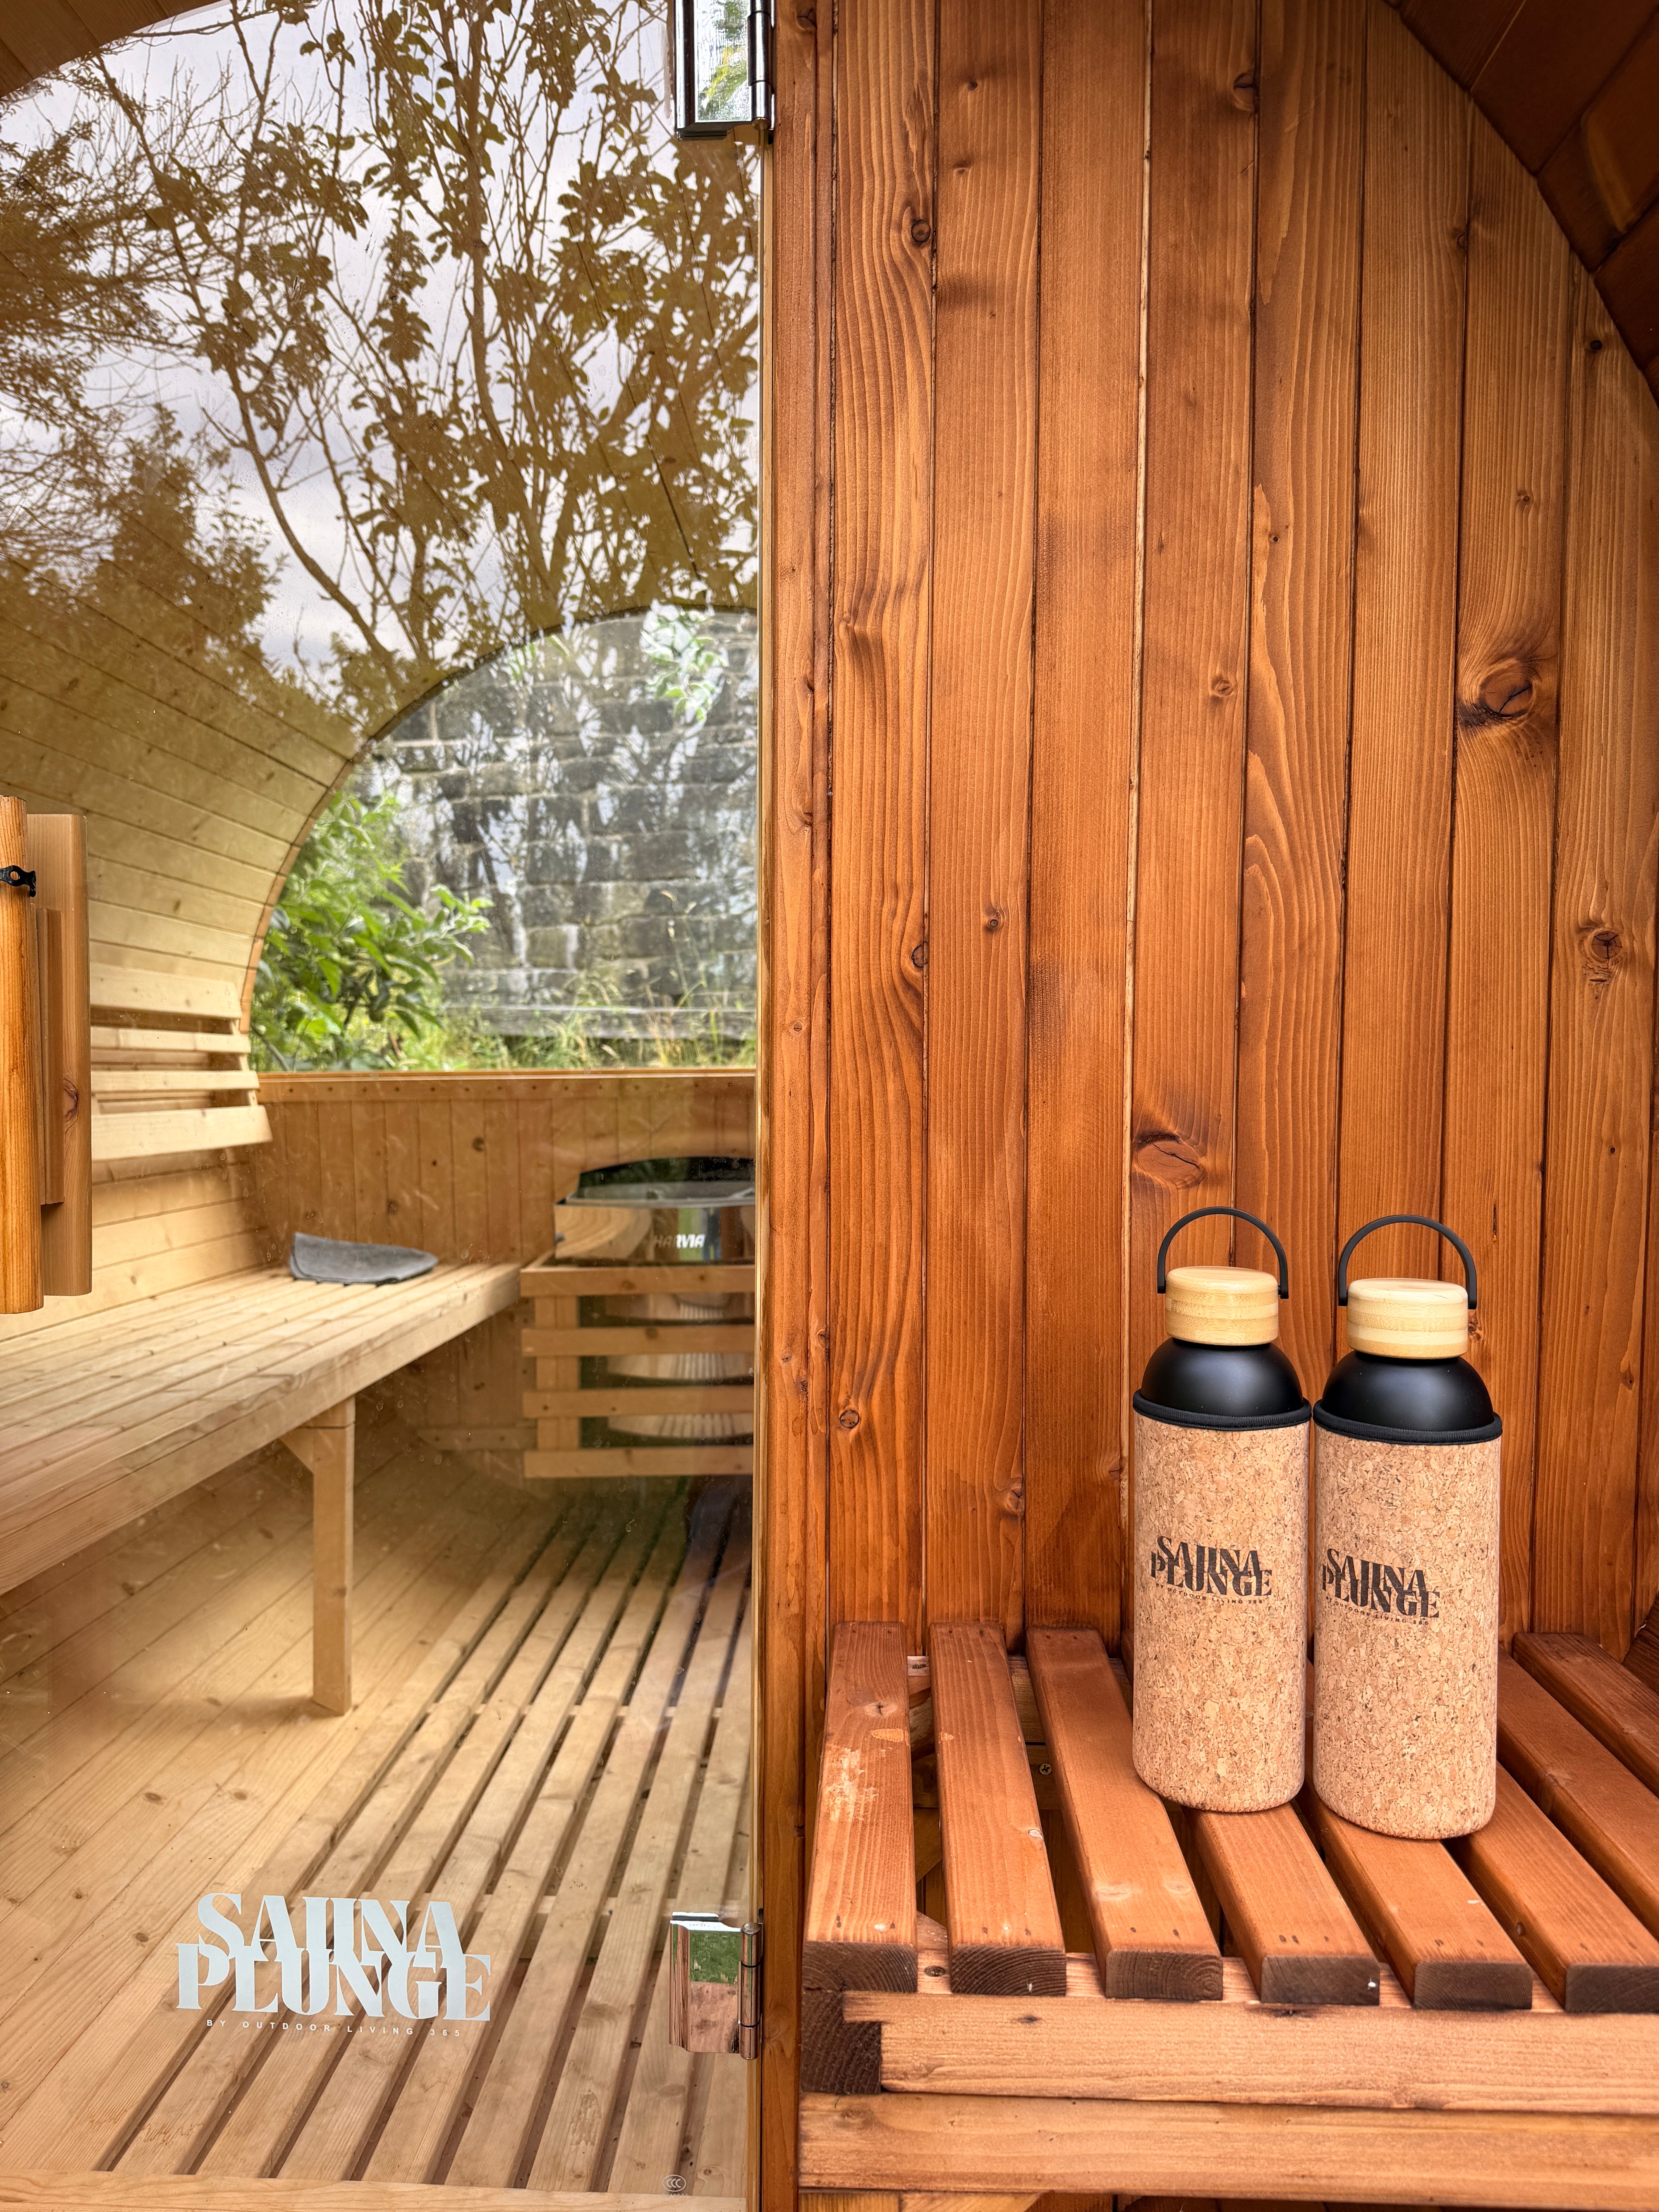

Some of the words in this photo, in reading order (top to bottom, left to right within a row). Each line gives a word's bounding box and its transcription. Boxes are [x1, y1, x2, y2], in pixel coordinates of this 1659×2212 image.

[1151, 1550, 1272, 1596] PLUNGE
[1157, 1536, 1261, 1578] SAUNA
[1327, 1548, 1428, 1596] SAUNA
[1168, 1587, 1206, 1600] OUTDOOR
[1322, 1563, 1440, 1618] PLUNGE
[1334, 1601, 1370, 1616] OUTDOOR
[1375, 1614, 1407, 1623] LIVING
[198, 1893, 467, 1969] SAUNA
[175, 1936, 491, 2021] PLUNGE
[242, 2021, 330, 2031] OUTDOOR
[347, 2026, 413, 2035] LIVING
